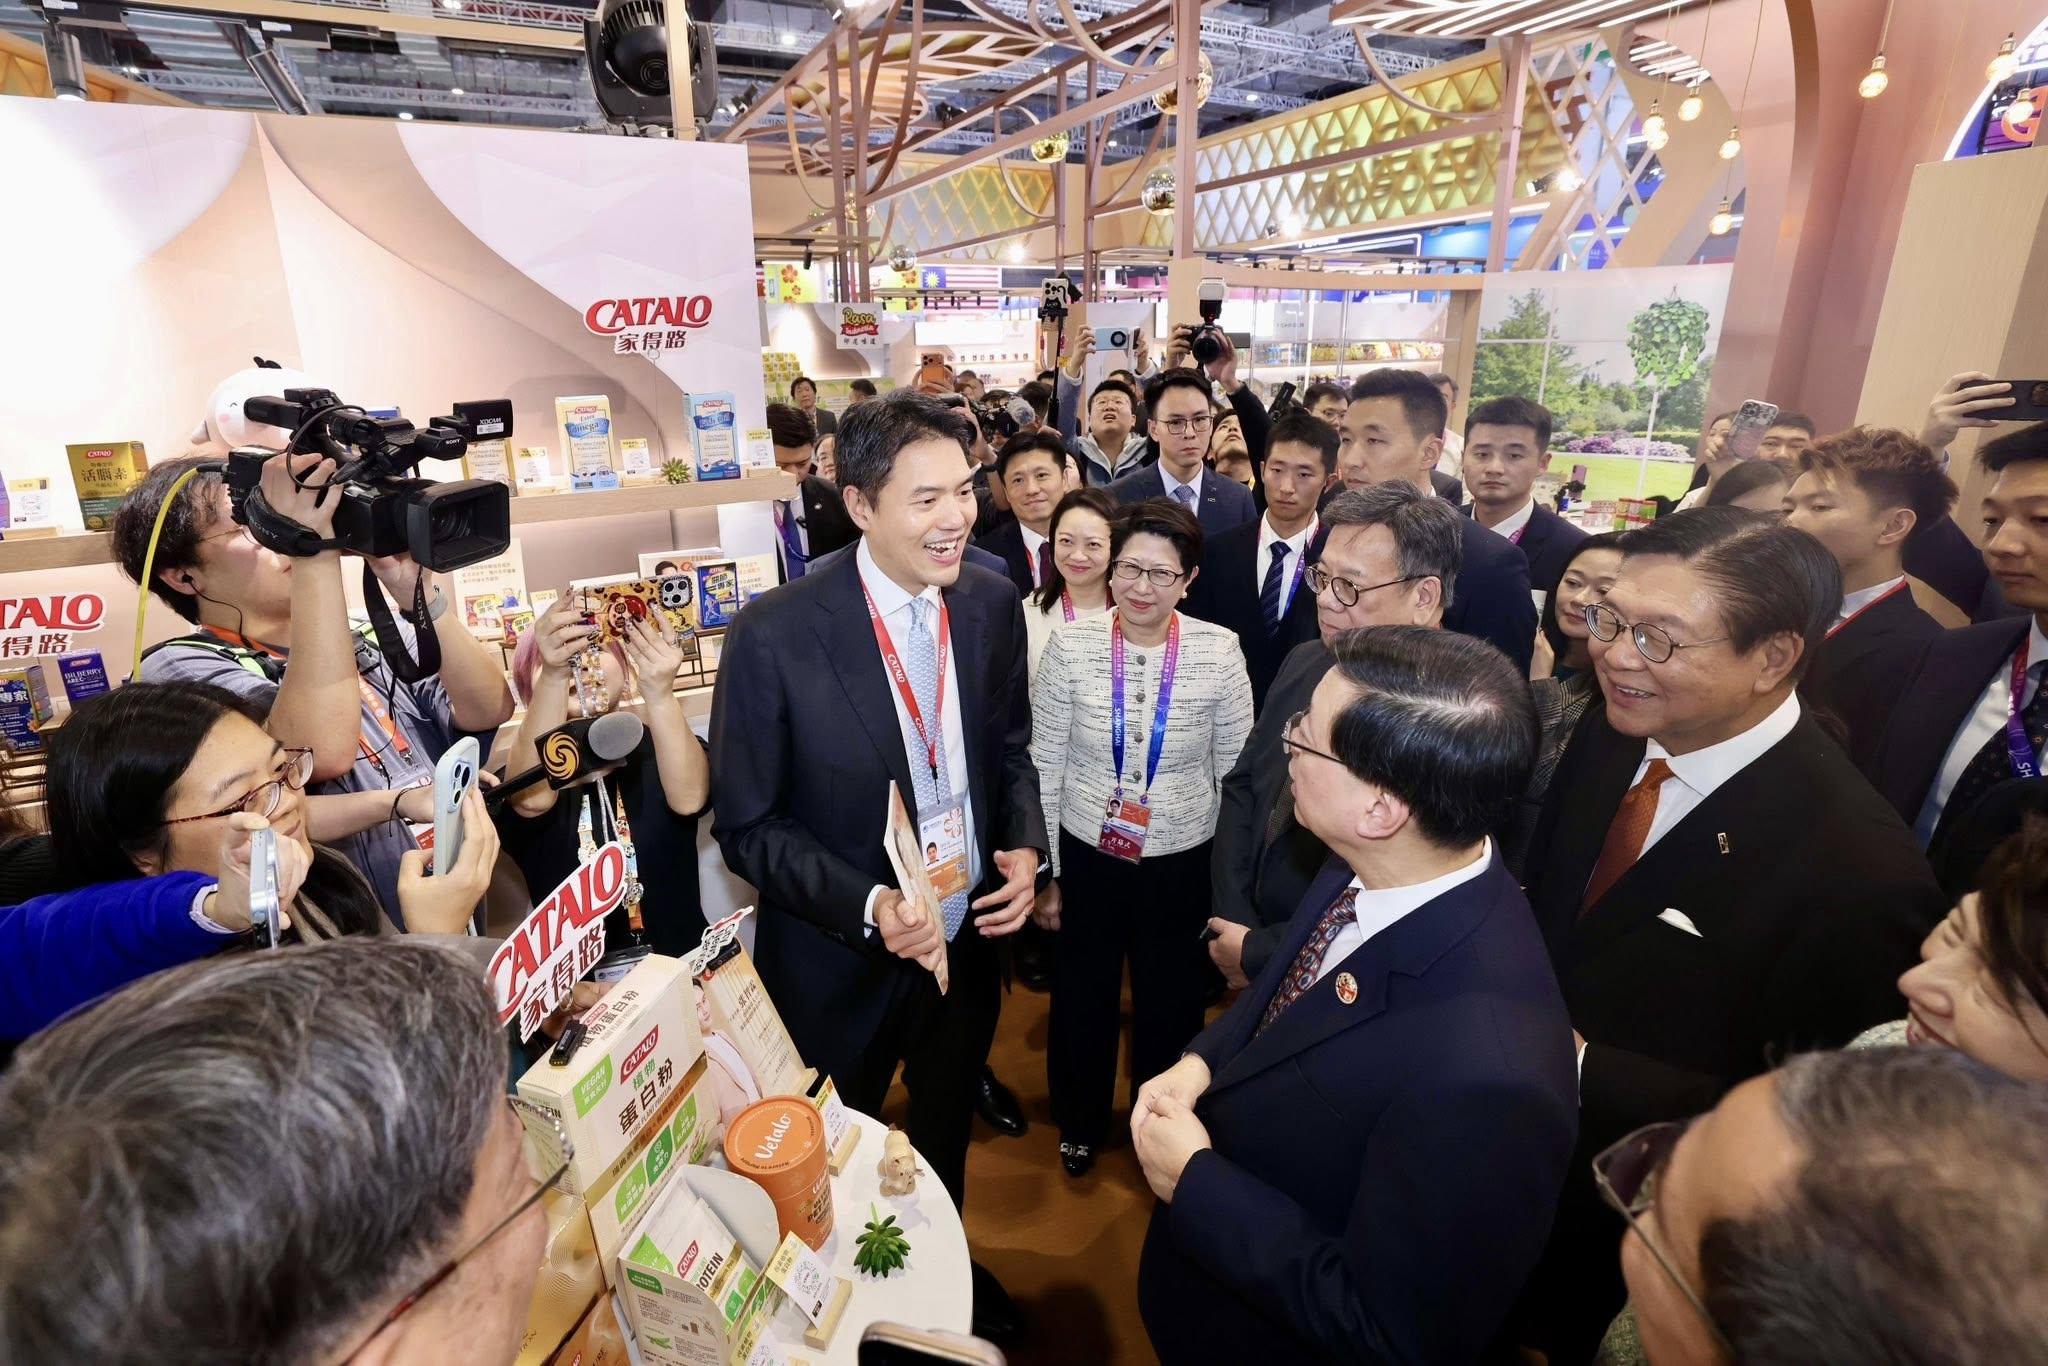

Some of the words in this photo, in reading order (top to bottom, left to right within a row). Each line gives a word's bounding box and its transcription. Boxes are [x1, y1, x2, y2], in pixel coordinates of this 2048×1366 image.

[586, 295, 712, 334] CATALO
[842, 307, 876, 325] Rasa
[617, 330, 687, 352] 家得路
[87, 450, 112, 458] CATALO
[416, 590, 428, 630] SONY
[3, 633, 68, 658] 得路
[938, 644, 948, 676] CATALO
[887, 653, 906, 684] CATALO
[1113, 707, 1122, 747] SHANGHAI
[490, 846, 626, 1022] CATALO
[522, 923, 602, 1037] 家得路
[623, 1032, 656, 1075] CATALO
[582, 1065, 605, 1092] VEGAN
[633, 1058, 656, 1091] 植物
[619, 1058, 673, 1135] 蛋白粉
[755, 1112, 792, 1159] Vetalo
